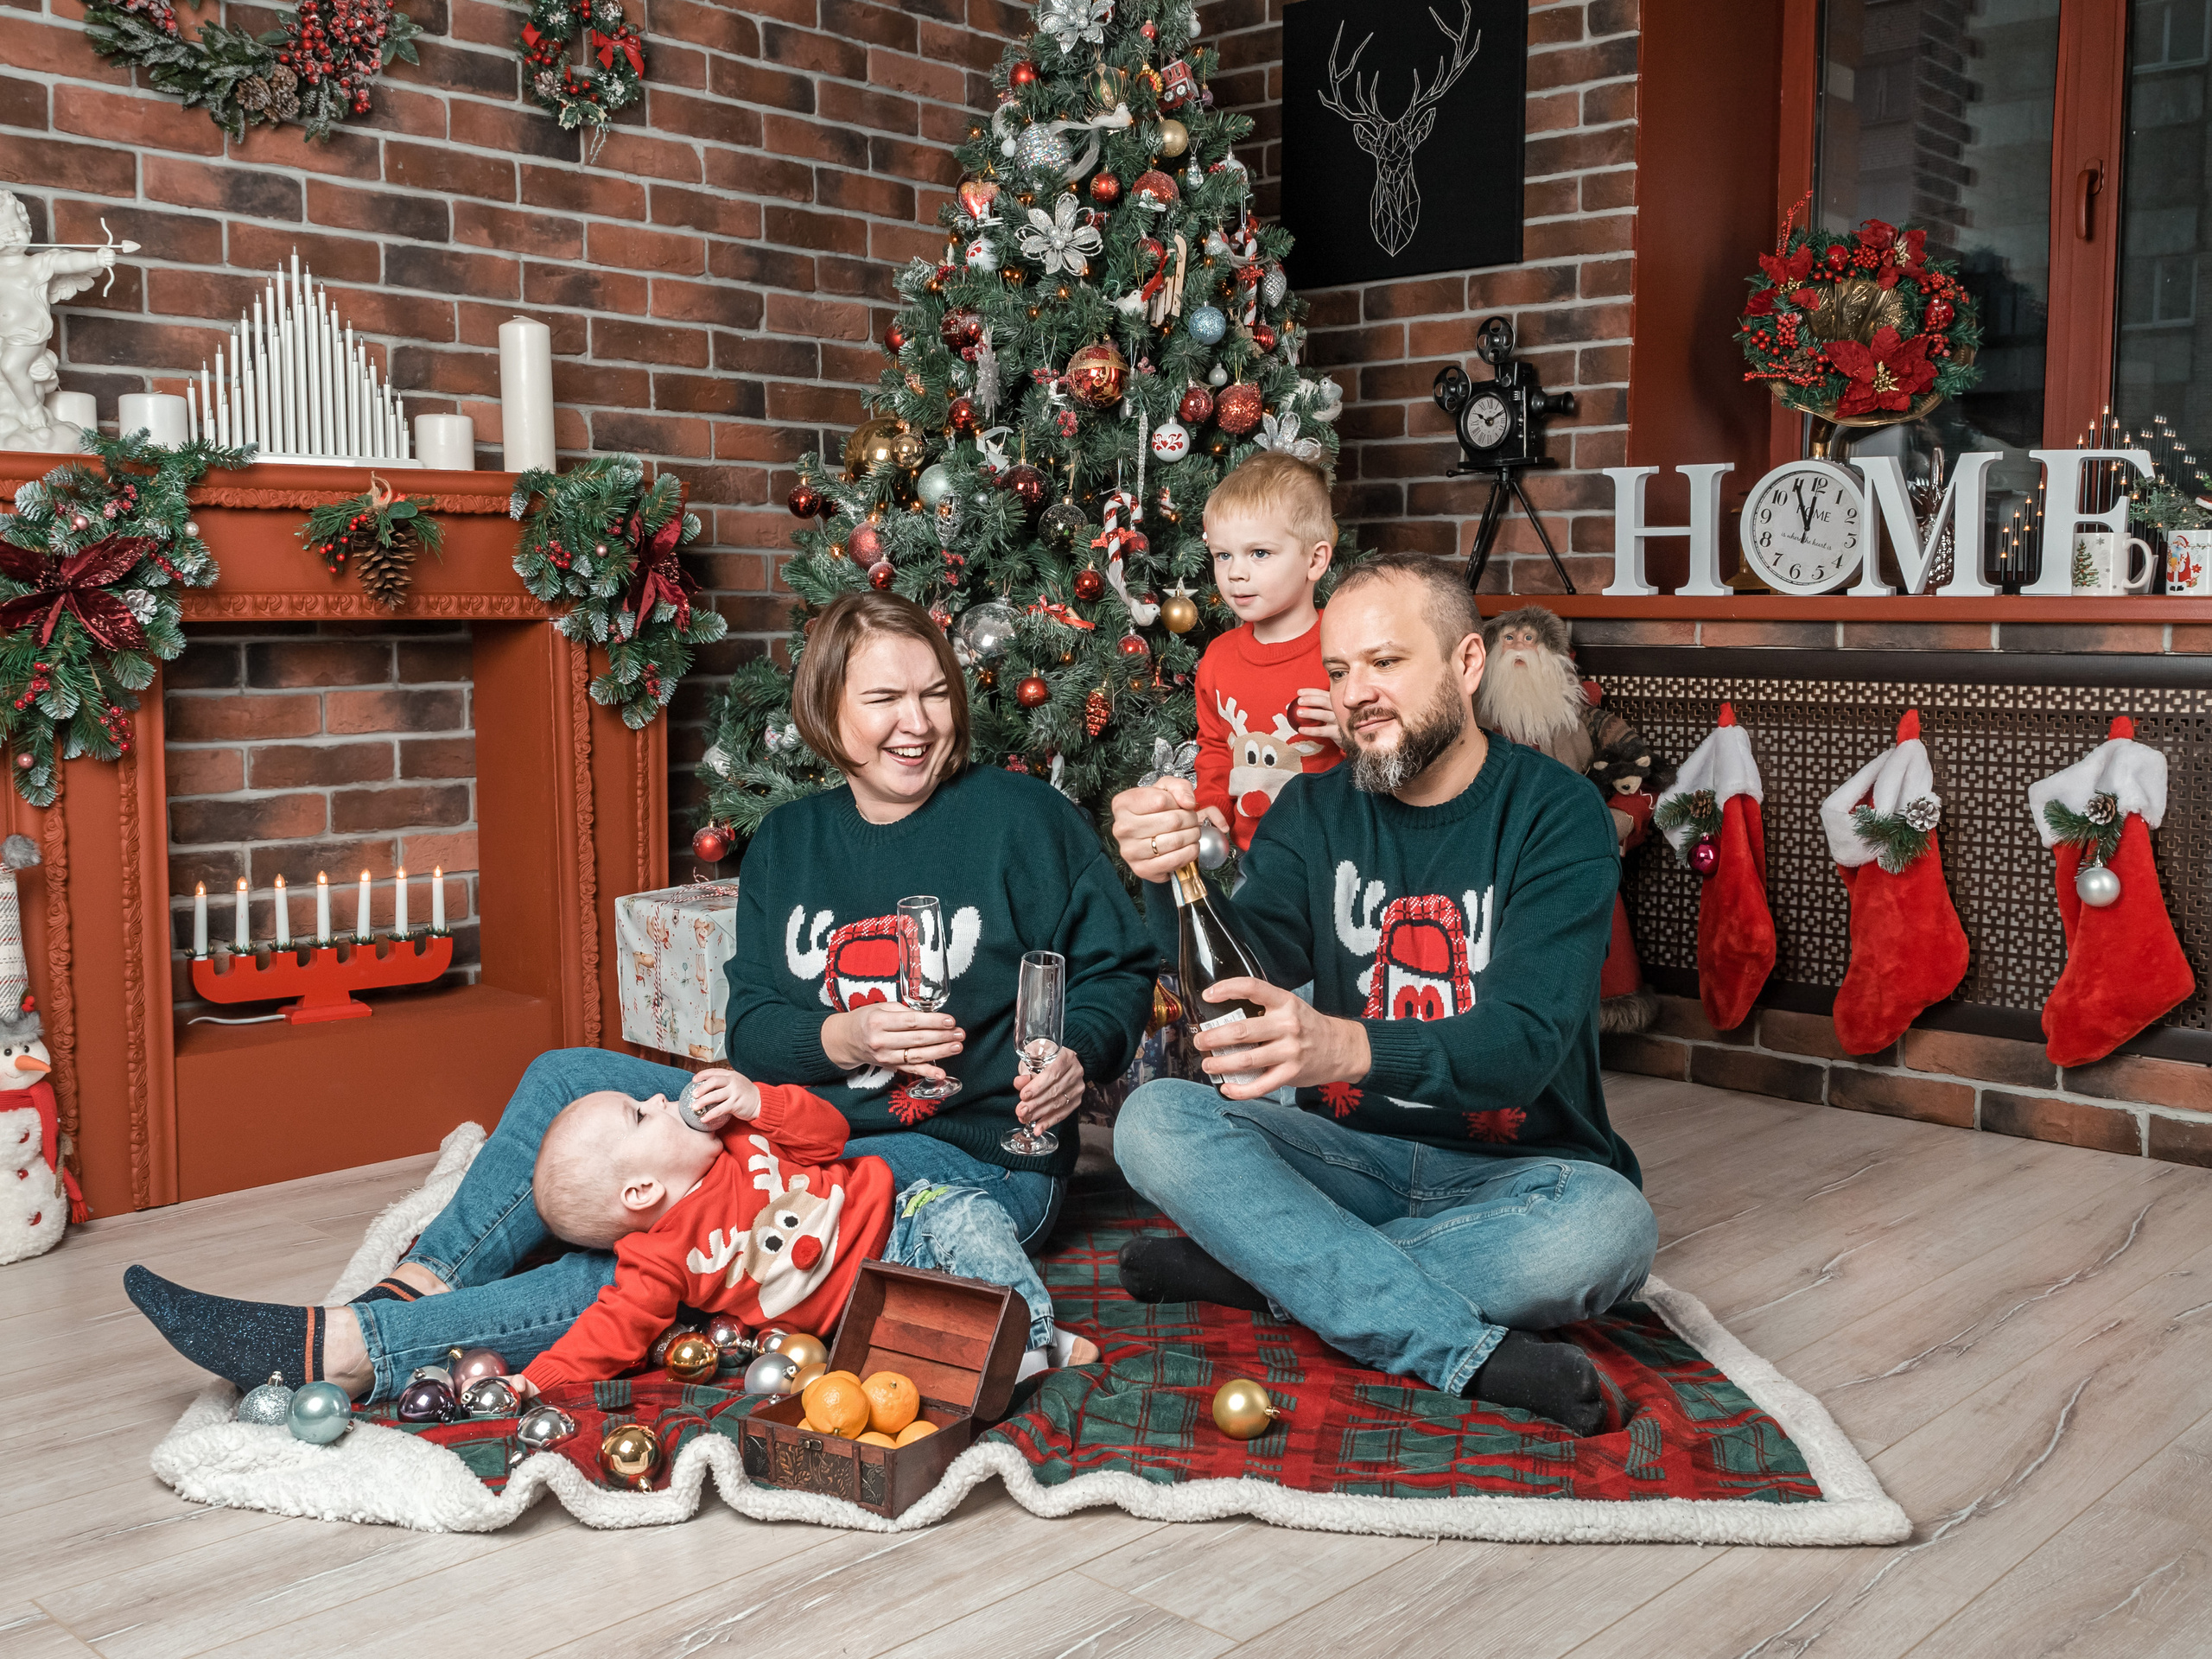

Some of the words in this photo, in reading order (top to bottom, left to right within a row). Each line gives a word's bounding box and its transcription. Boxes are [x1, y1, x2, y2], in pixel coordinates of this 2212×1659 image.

[1791, 477, 1805, 493] 11
[1810, 477, 1828, 494] 12
[1771, 489, 1789, 506] 10
[1834, 489, 1844, 505] 1
[1760, 508, 1772, 524] 9
[1844, 507, 1858, 524] 2
[1759, 531, 1772, 547] 8
[1843, 532, 1857, 549] 3
[1772, 552, 1783, 567] 7
[1831, 553, 1844, 569] 4
[1789, 563, 1802, 580] 6
[1811, 565, 1825, 580] 5
